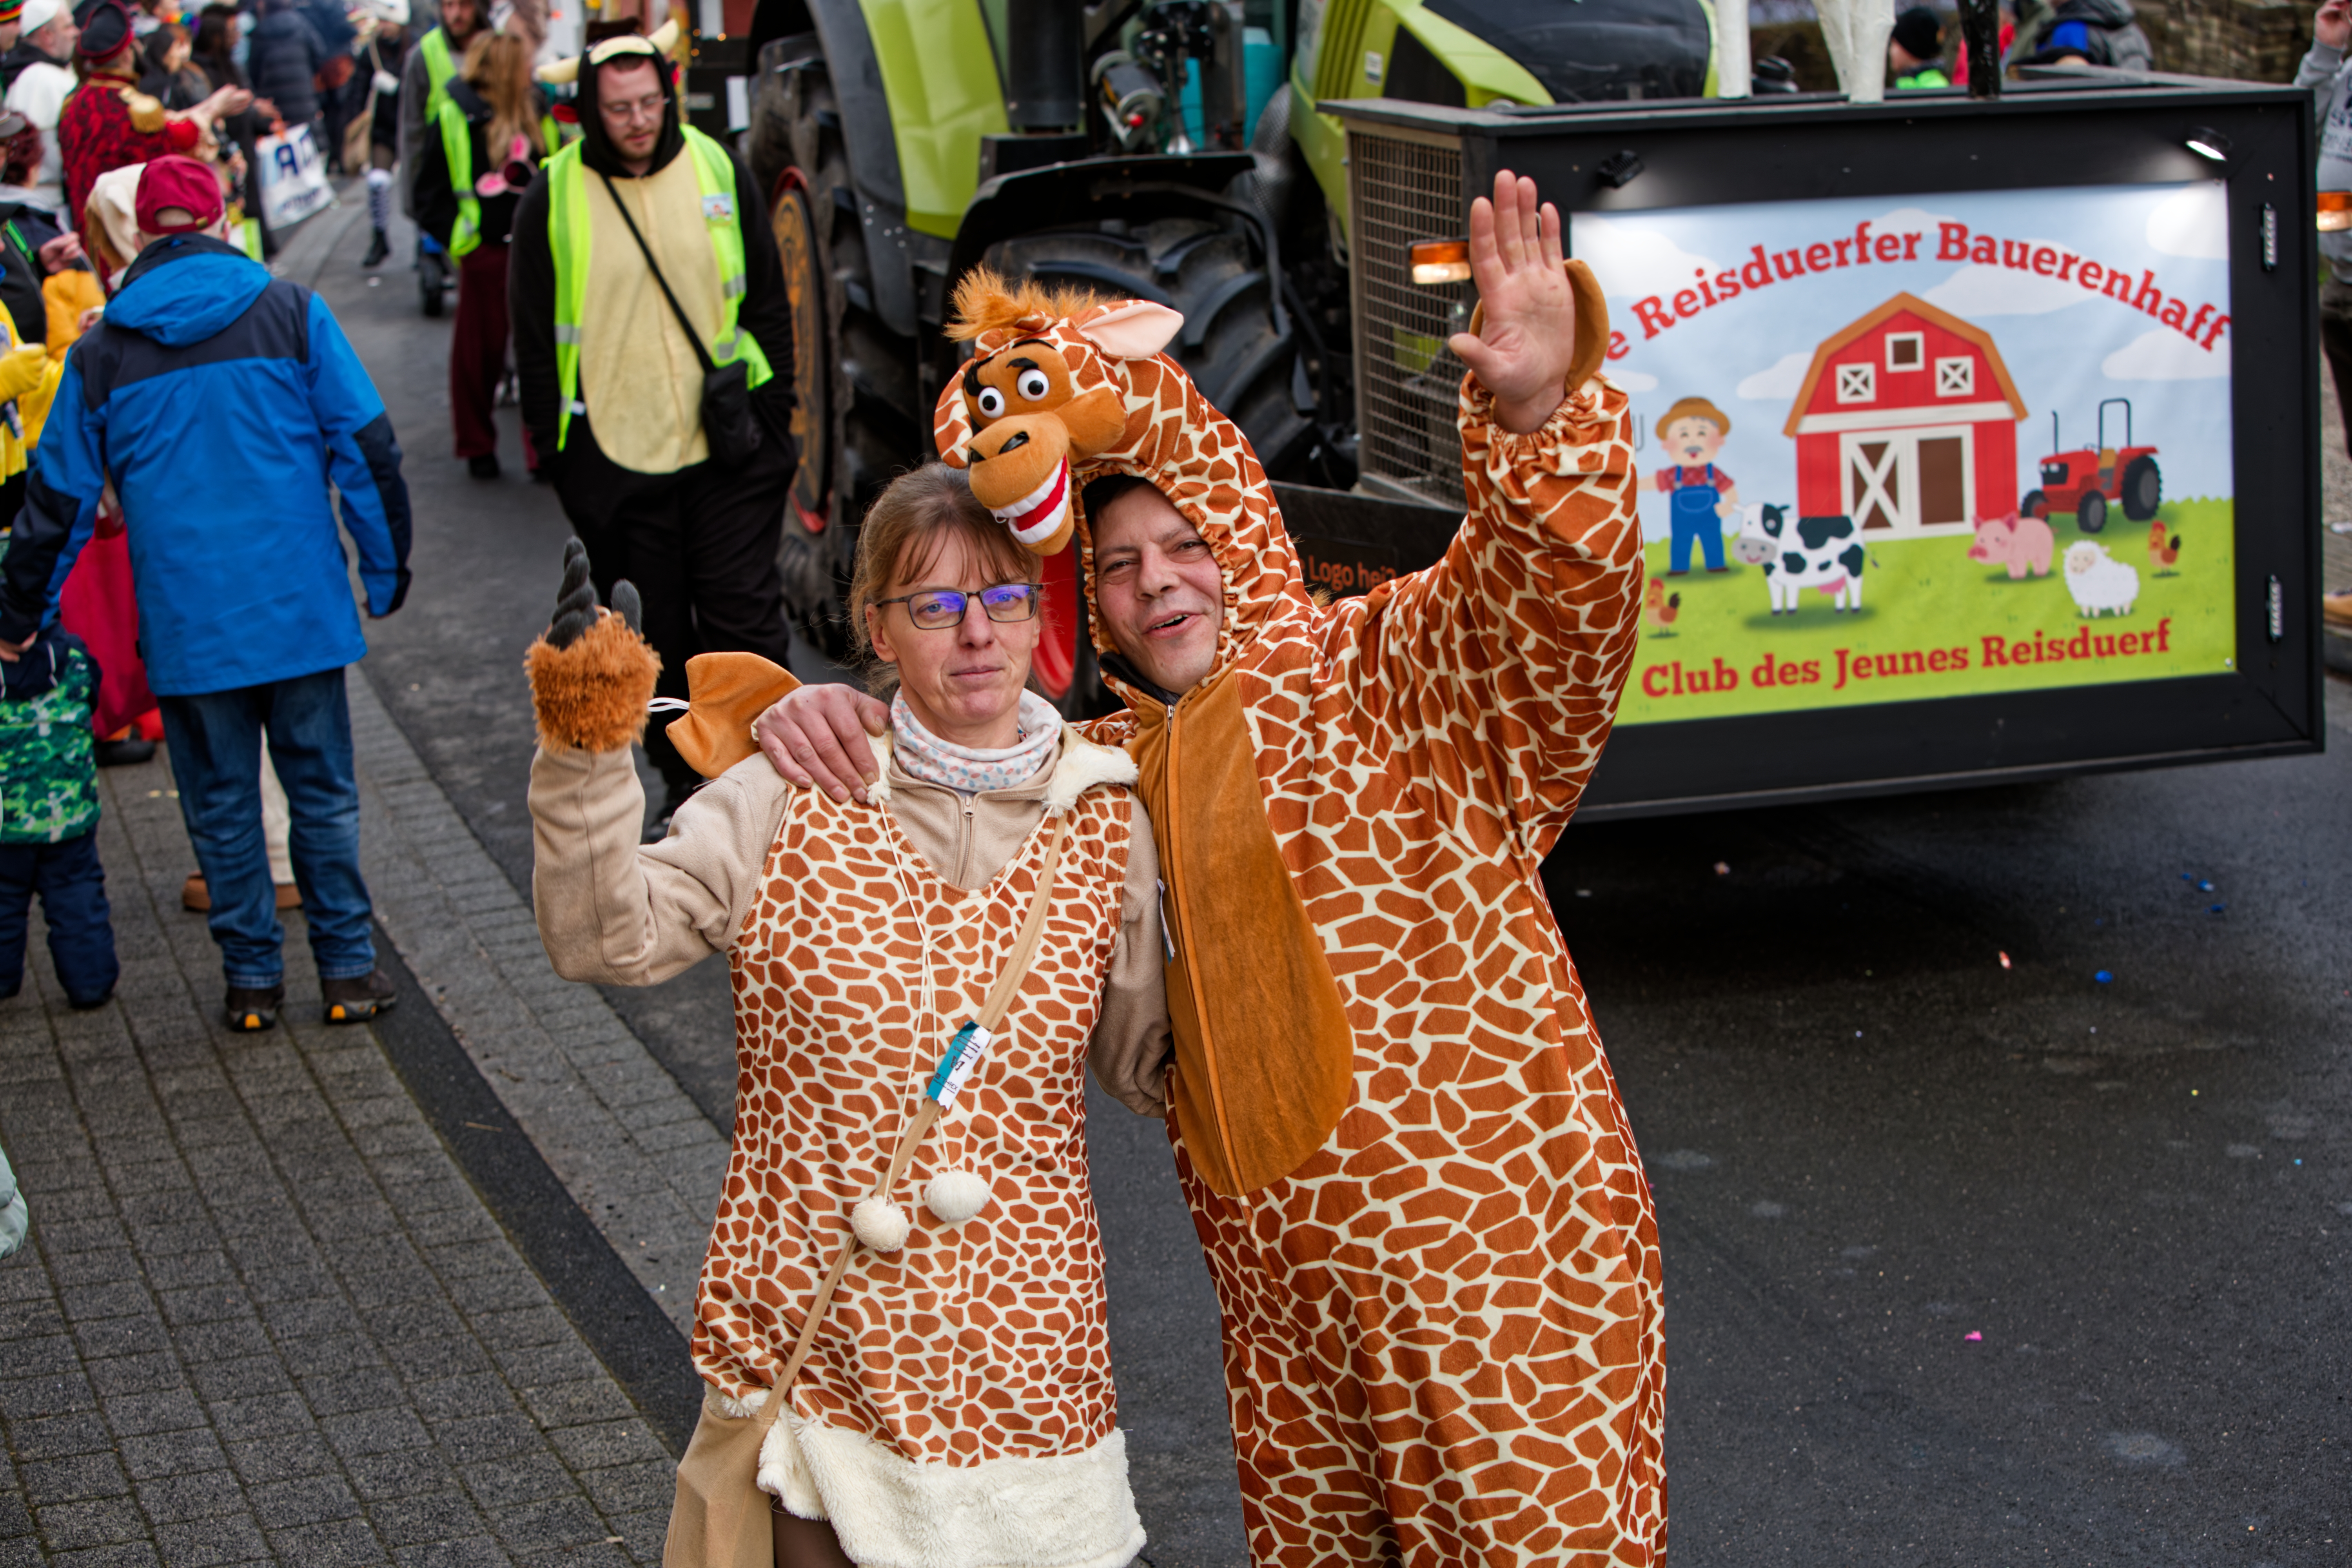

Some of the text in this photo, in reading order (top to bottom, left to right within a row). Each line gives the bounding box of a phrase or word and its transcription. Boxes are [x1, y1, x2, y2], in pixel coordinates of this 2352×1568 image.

[1605, 220, 2231, 361] e Reisduerfer Bauerenhaff
[1308, 555, 1354, 592] Logo
[1641, 617, 2172, 698] Club des Jeunes Reisduerf
